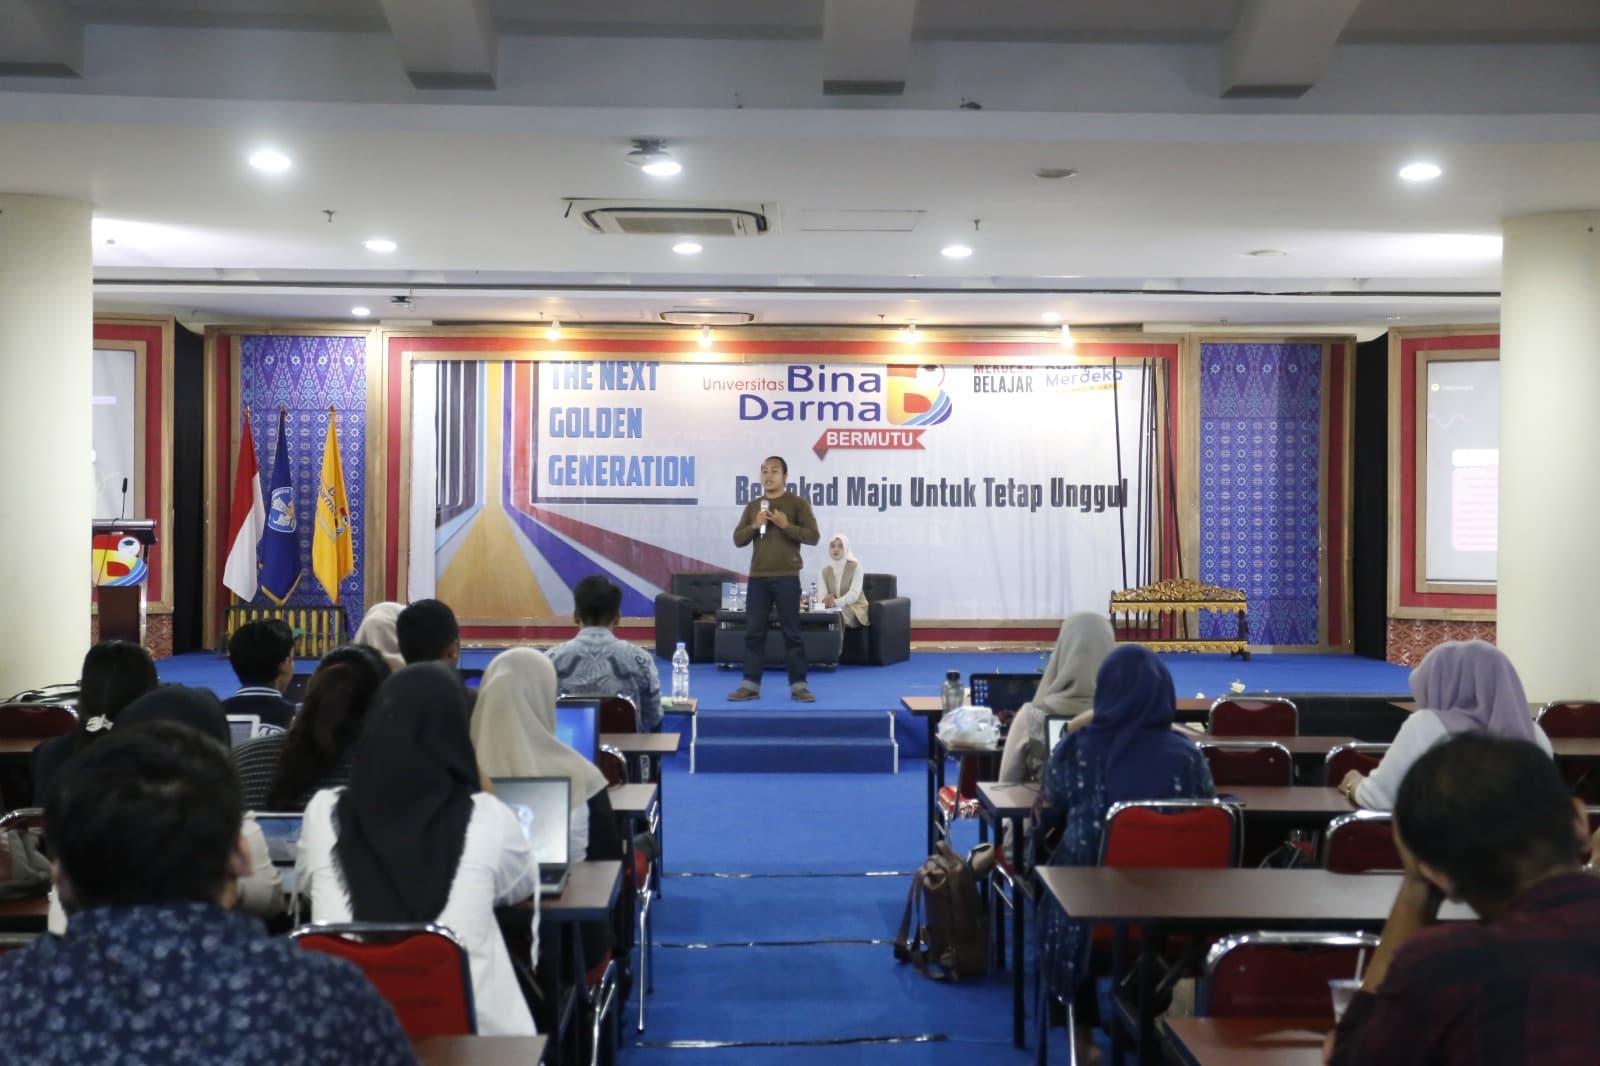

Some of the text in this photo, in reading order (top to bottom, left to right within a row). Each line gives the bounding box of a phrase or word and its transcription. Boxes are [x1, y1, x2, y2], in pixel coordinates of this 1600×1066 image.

[550, 361, 660, 390] THE NEXT
[703, 364, 881, 393] Universitas Bina
[973, 376, 1033, 393] BELAJAR
[549, 407, 643, 438] GOLDEN
[739, 394, 881, 422] Darma
[826, 431, 913, 446] BERMUTU
[548, 455, 695, 487] GENERATION
[735, 475, 1128, 513] Bekad Maju Untuk Tetap Unggul
